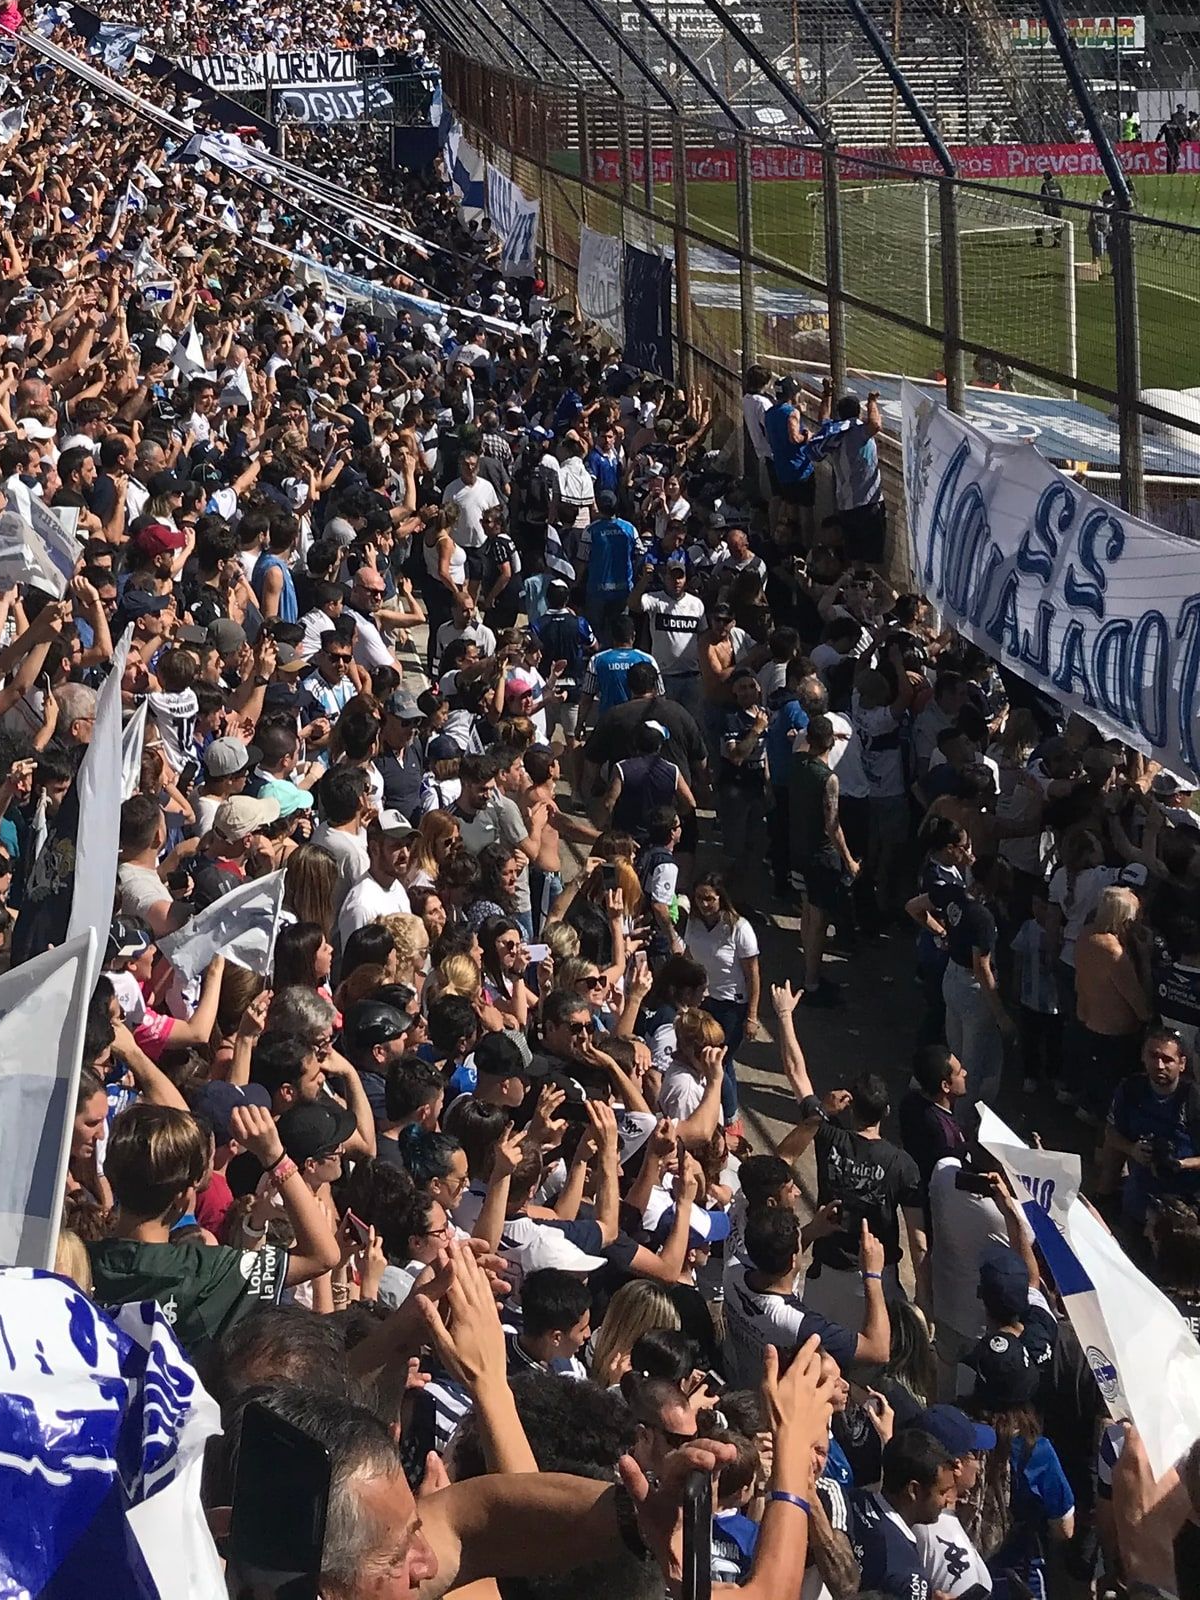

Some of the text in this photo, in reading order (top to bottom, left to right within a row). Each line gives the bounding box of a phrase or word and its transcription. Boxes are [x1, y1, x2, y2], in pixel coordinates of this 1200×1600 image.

[261, 50, 356, 84] LORENZO
[748, 154, 807, 179] alud
[912, 158, 992, 174] SEGROS
[1007, 149, 1150, 174] Prevenón
